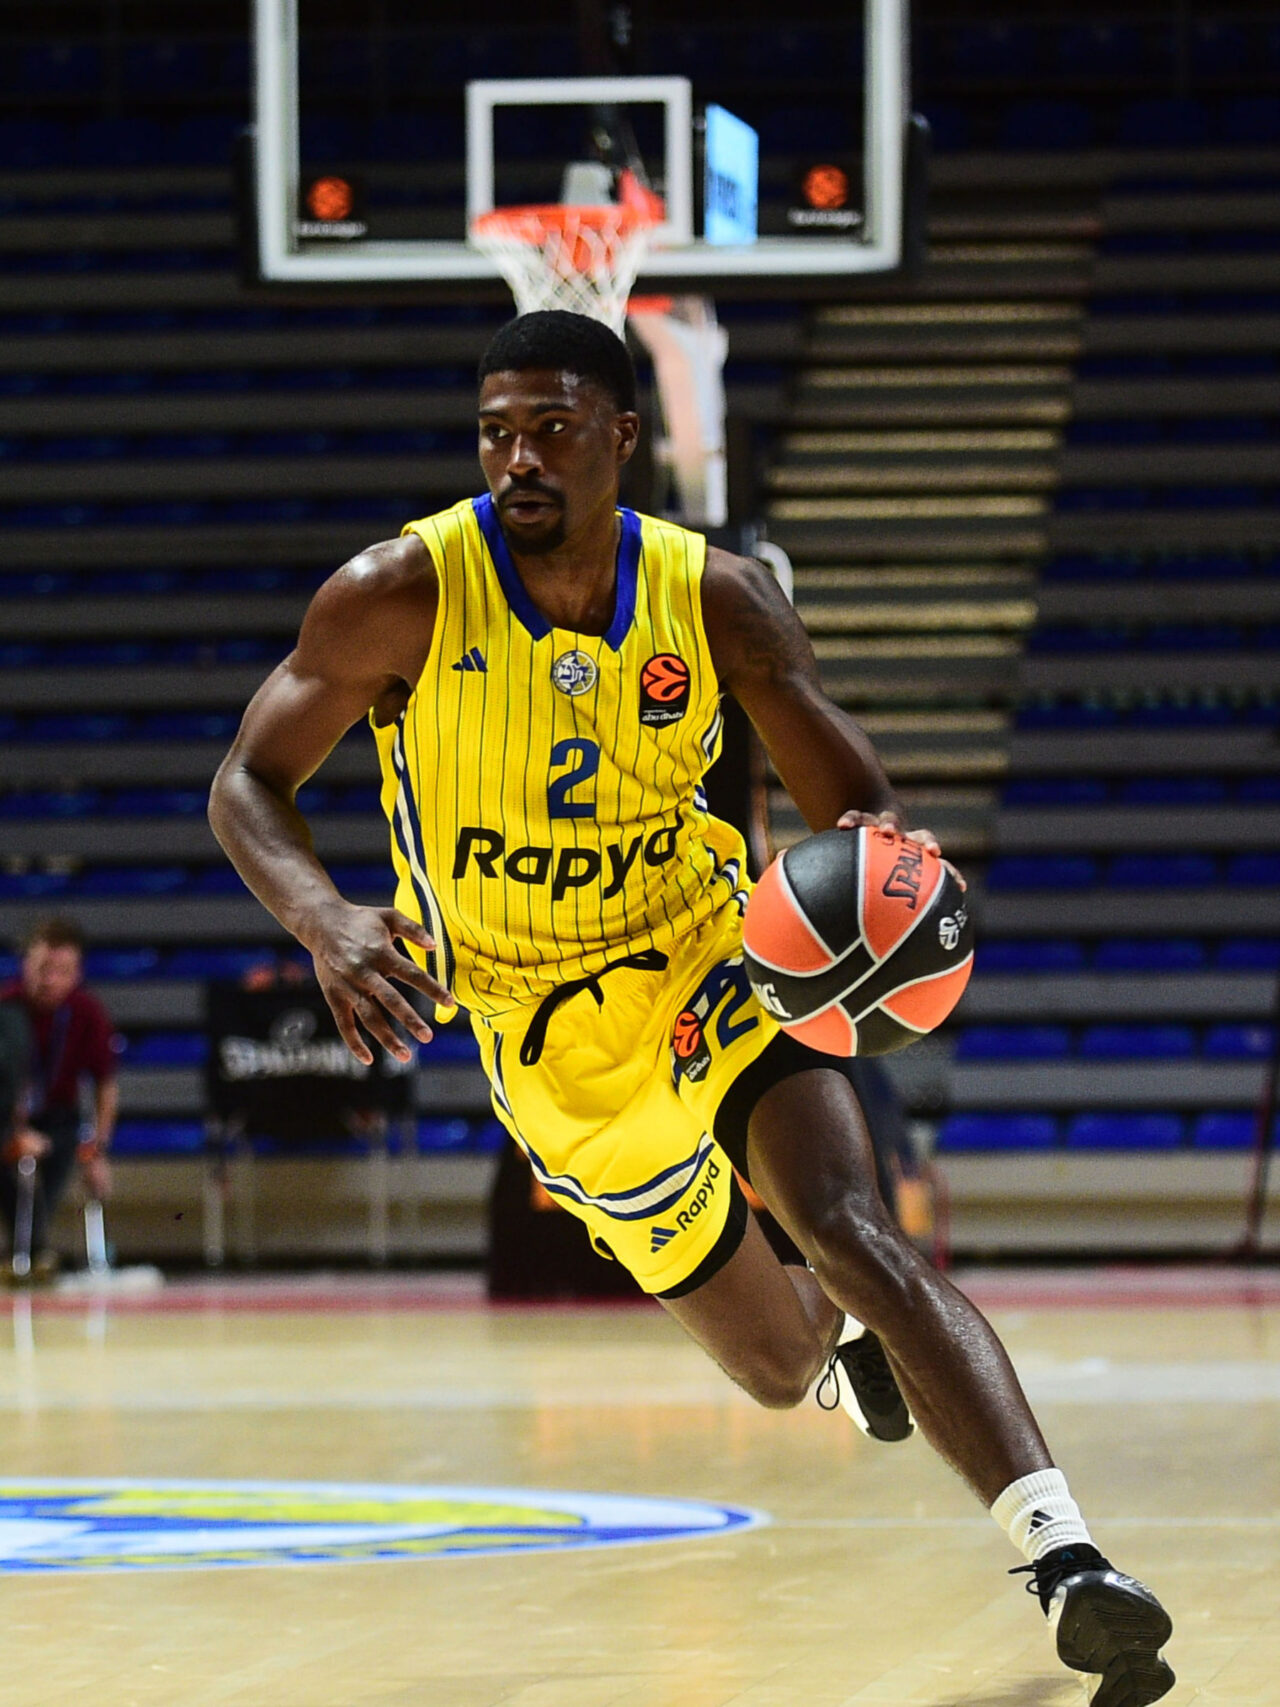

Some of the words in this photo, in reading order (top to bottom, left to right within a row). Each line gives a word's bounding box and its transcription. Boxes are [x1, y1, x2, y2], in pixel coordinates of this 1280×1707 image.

[547, 737, 602, 819] 2
[451, 806, 685, 901] Rapyd
[675, 1158, 721, 1231] Rapyd
